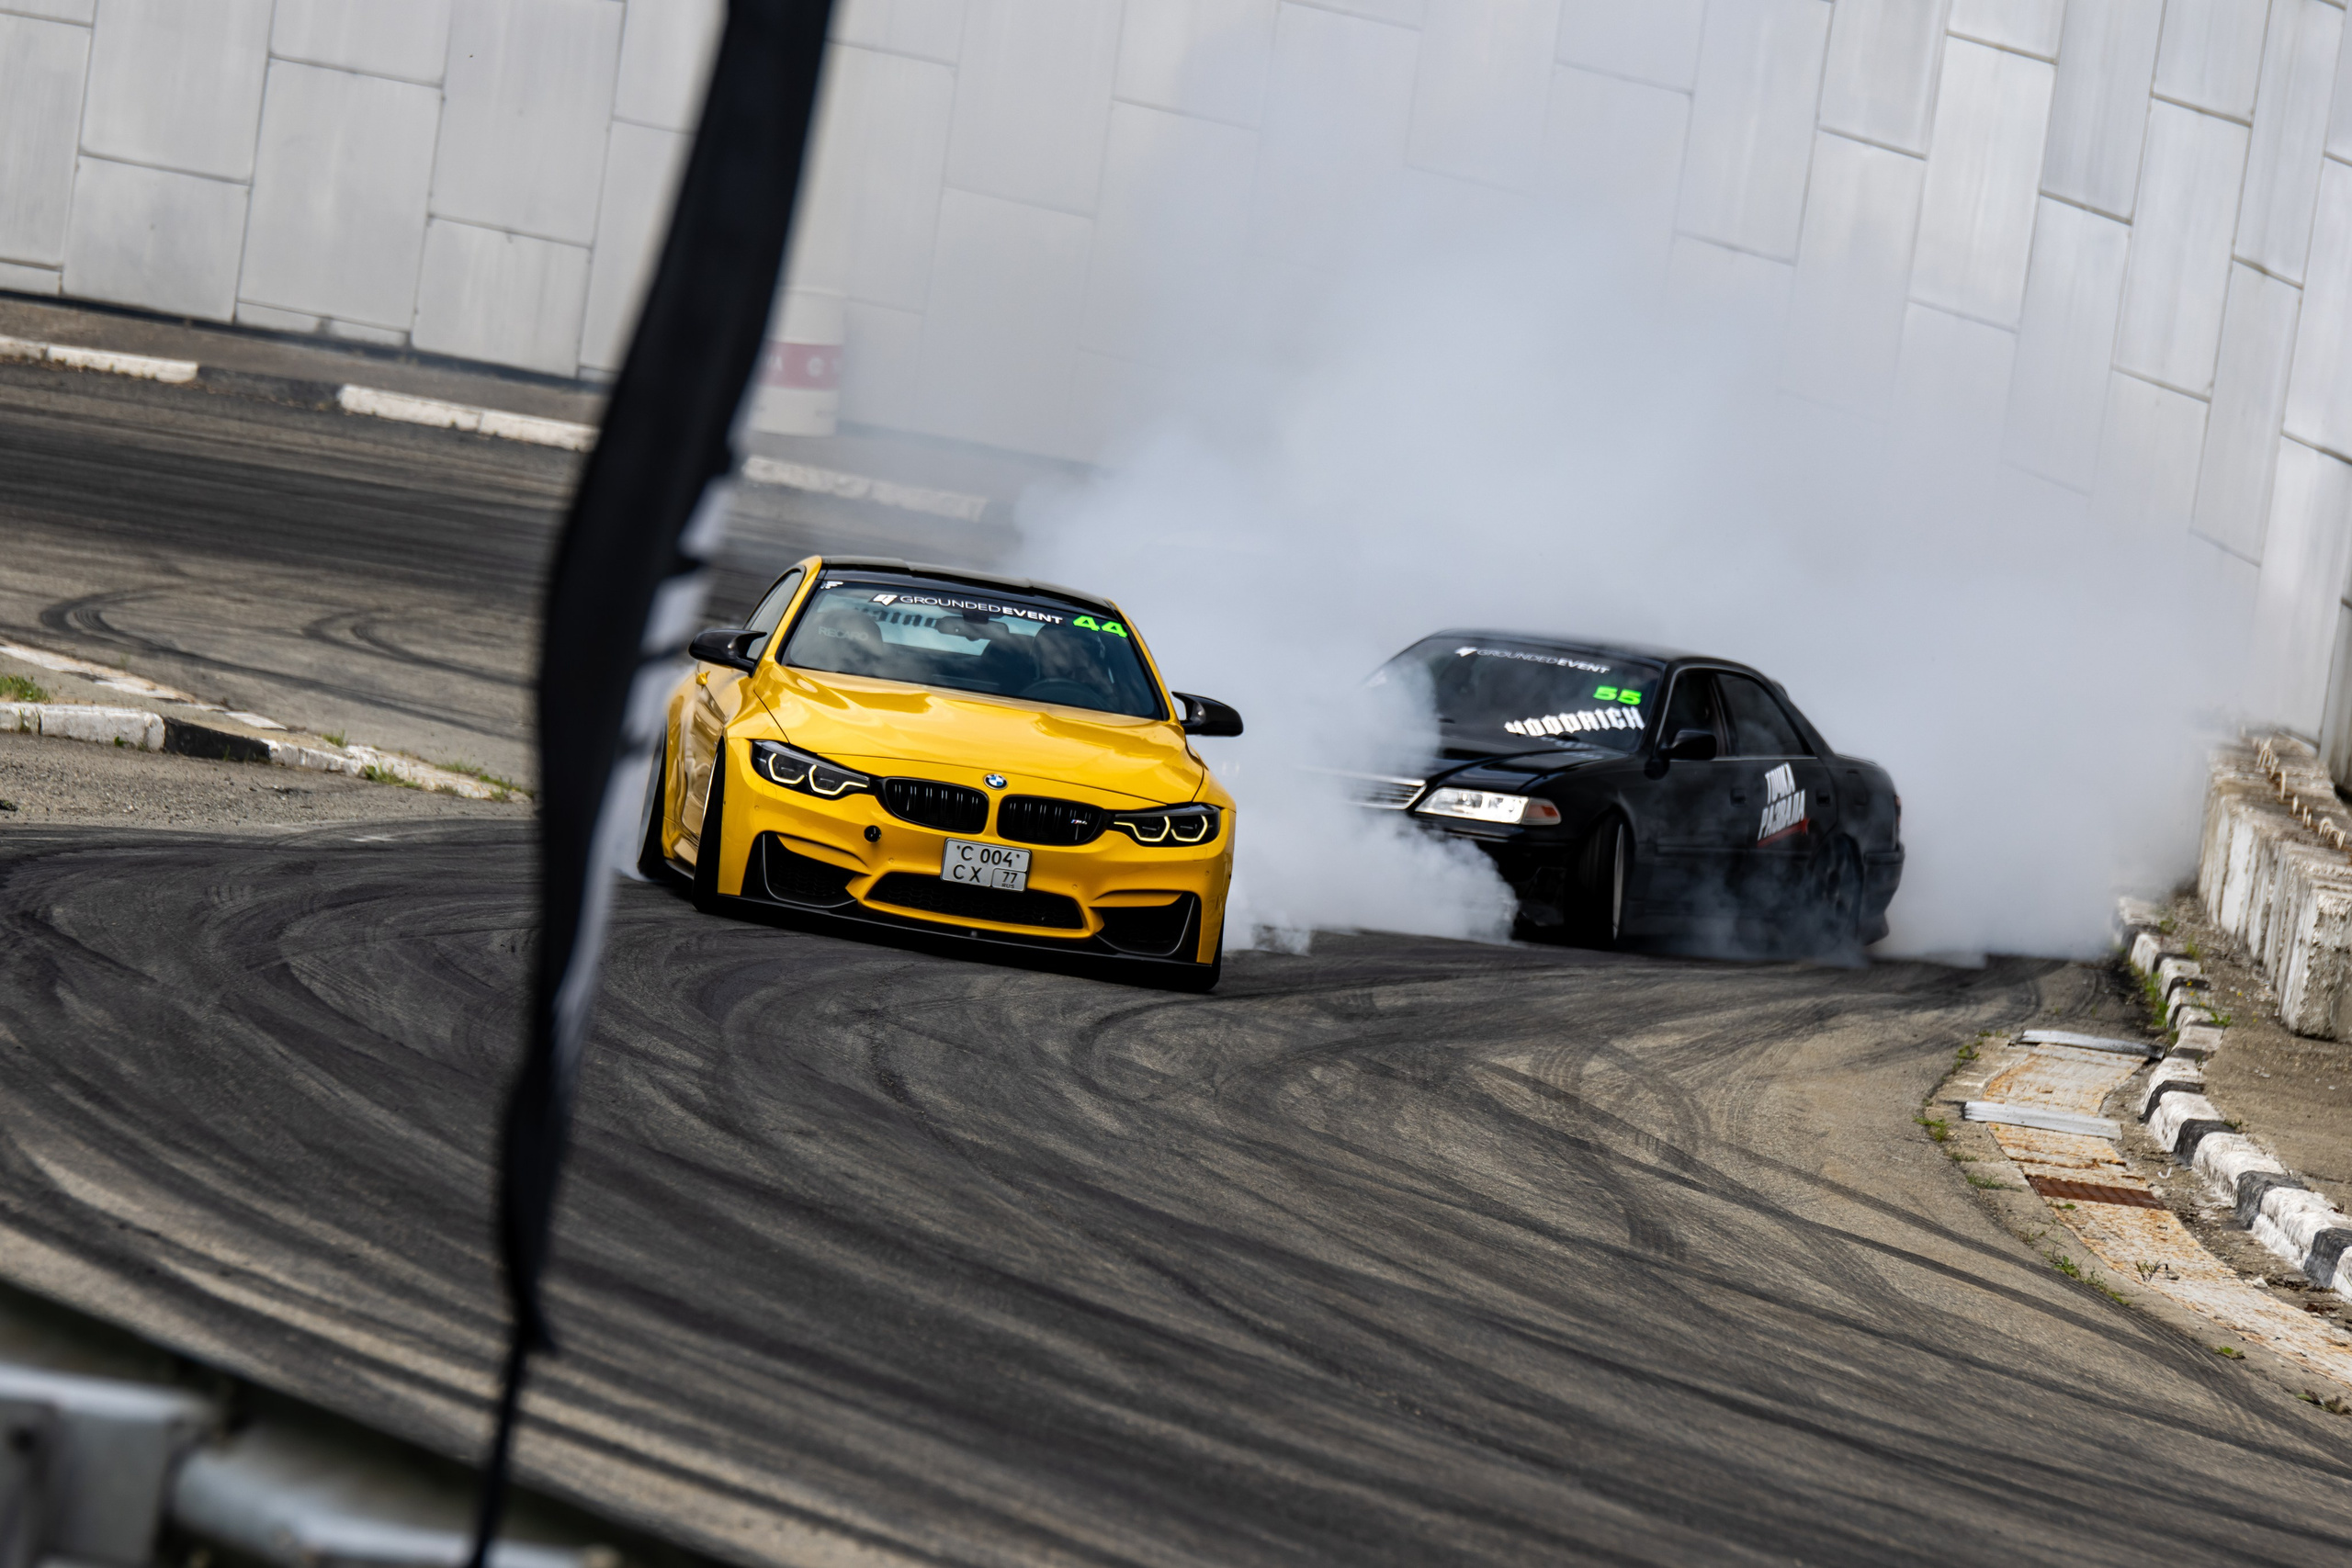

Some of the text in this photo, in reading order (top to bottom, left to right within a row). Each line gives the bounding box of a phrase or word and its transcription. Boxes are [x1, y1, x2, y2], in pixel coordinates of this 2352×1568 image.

[818, 626, 869, 642] RECARO
[1072, 615, 1128, 638] 44
[1592, 685, 1643, 705] 55
[979, 848, 1012, 868] 004
[1002, 871, 1018, 884] 77
